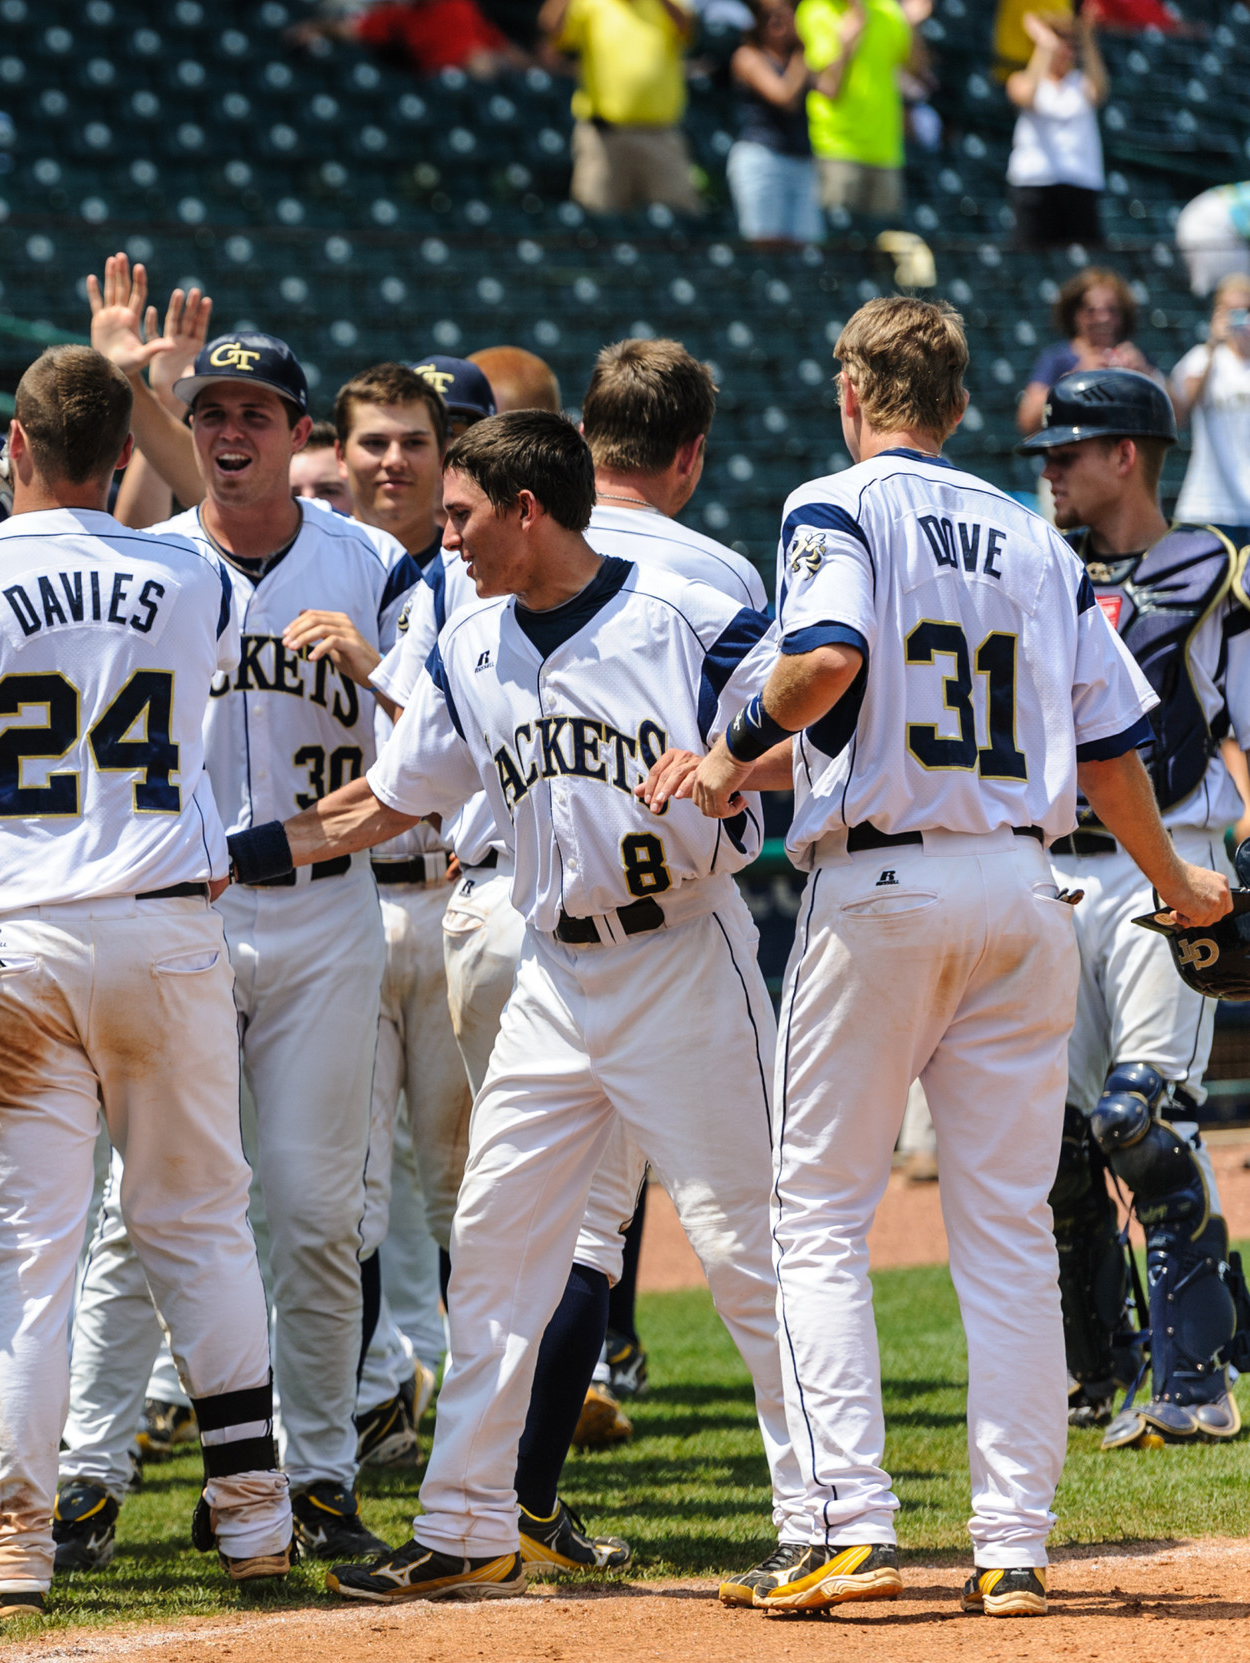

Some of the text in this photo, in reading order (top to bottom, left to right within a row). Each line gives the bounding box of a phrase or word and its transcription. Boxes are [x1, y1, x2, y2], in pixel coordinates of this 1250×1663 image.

[210, 342, 260, 371] GT
[917, 515, 1006, 580] DOVE
[2, 571, 165, 637] DAVIES
[904, 617, 1029, 783] 31
[293, 745, 364, 811] 30
[620, 831, 673, 898] 8
